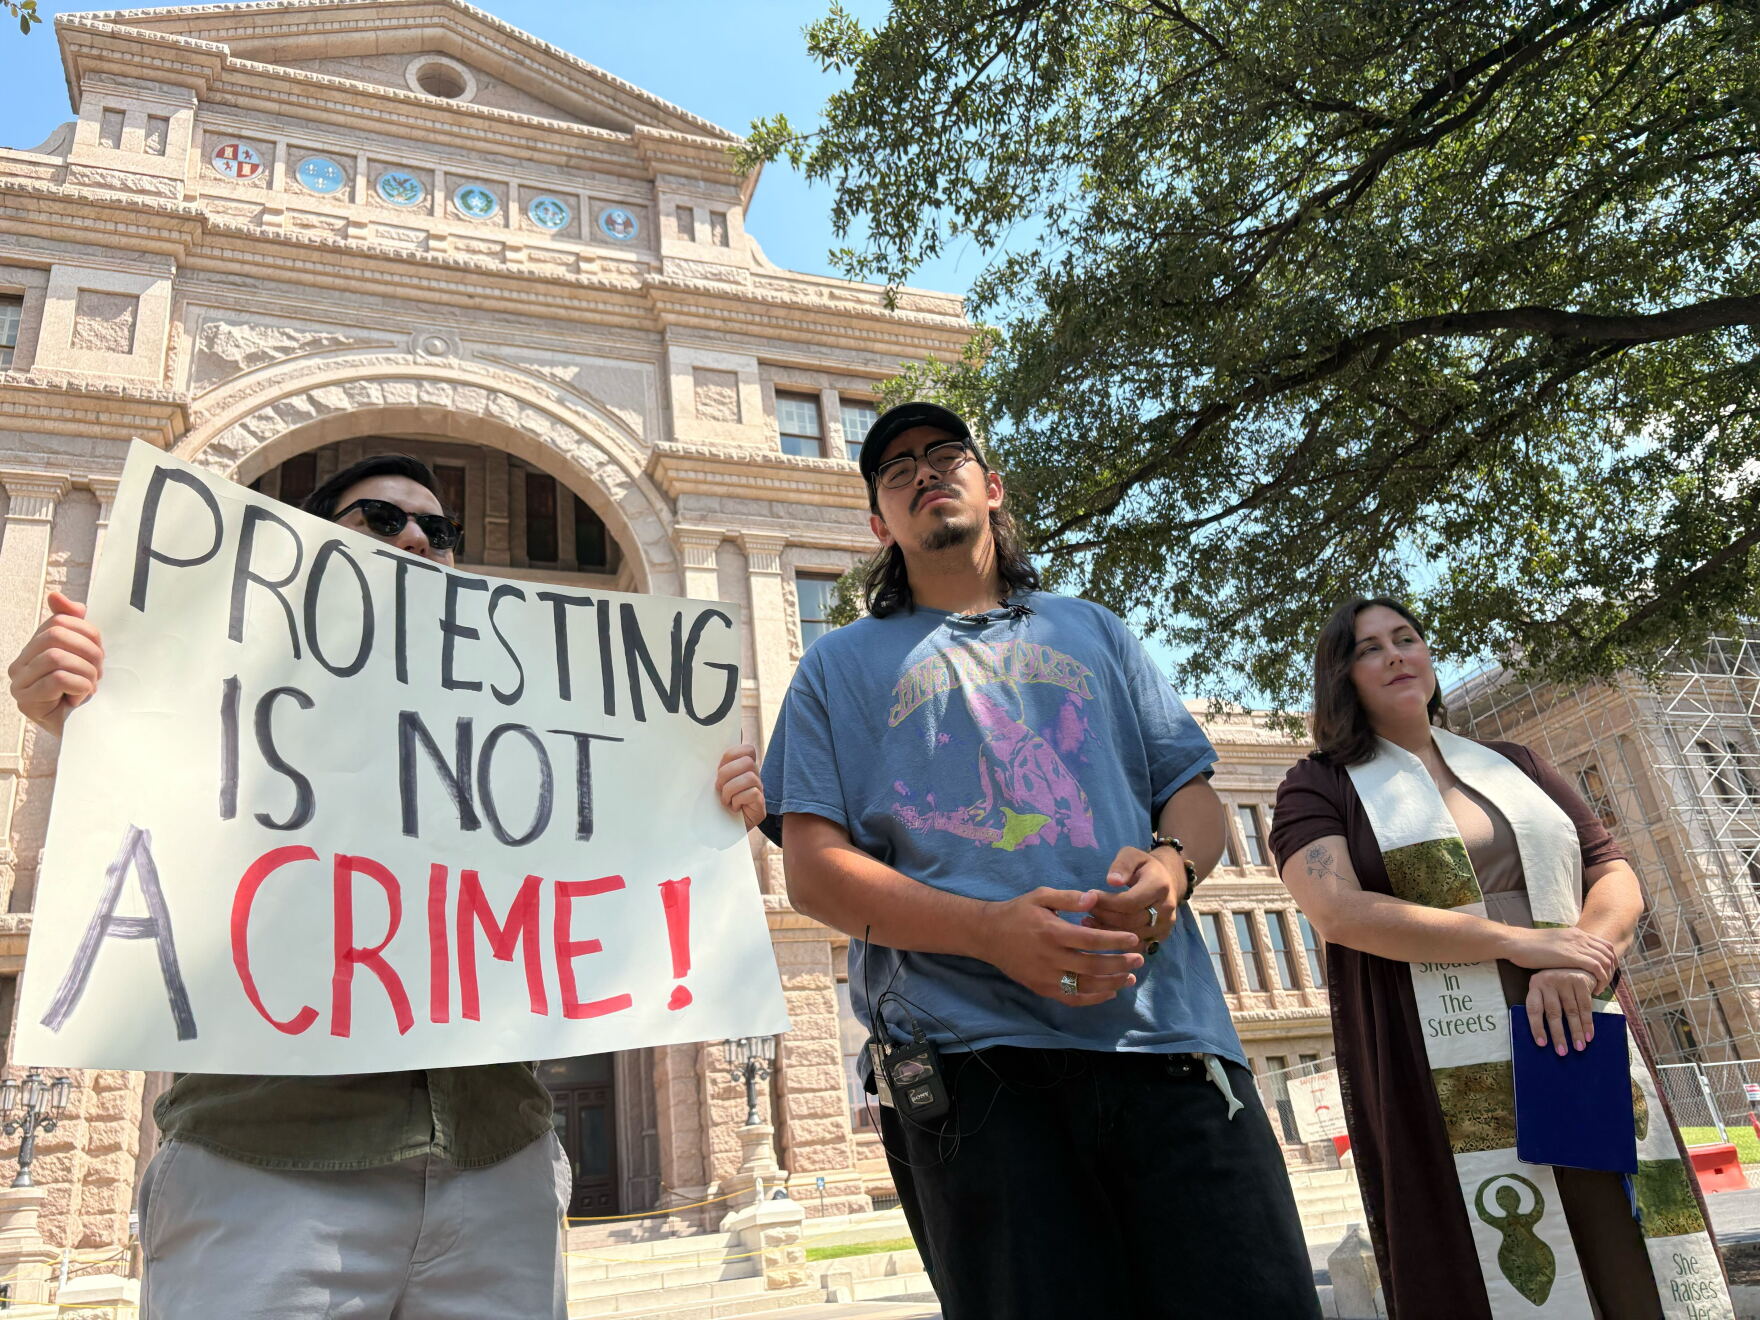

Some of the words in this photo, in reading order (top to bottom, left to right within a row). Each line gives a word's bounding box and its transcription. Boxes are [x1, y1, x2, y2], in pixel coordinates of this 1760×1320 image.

[129, 465, 739, 727] PROTESTING
[219, 674, 316, 832] IS
[398, 709, 625, 848] NOT
[39, 823, 198, 1042] A
[1443, 972, 1461, 992] In
[1438, 993, 1473, 1014] The
[1427, 1013, 1497, 1038] Streets
[1672, 1252, 1699, 1275] She
[1669, 1279, 1718, 1303] Raises
